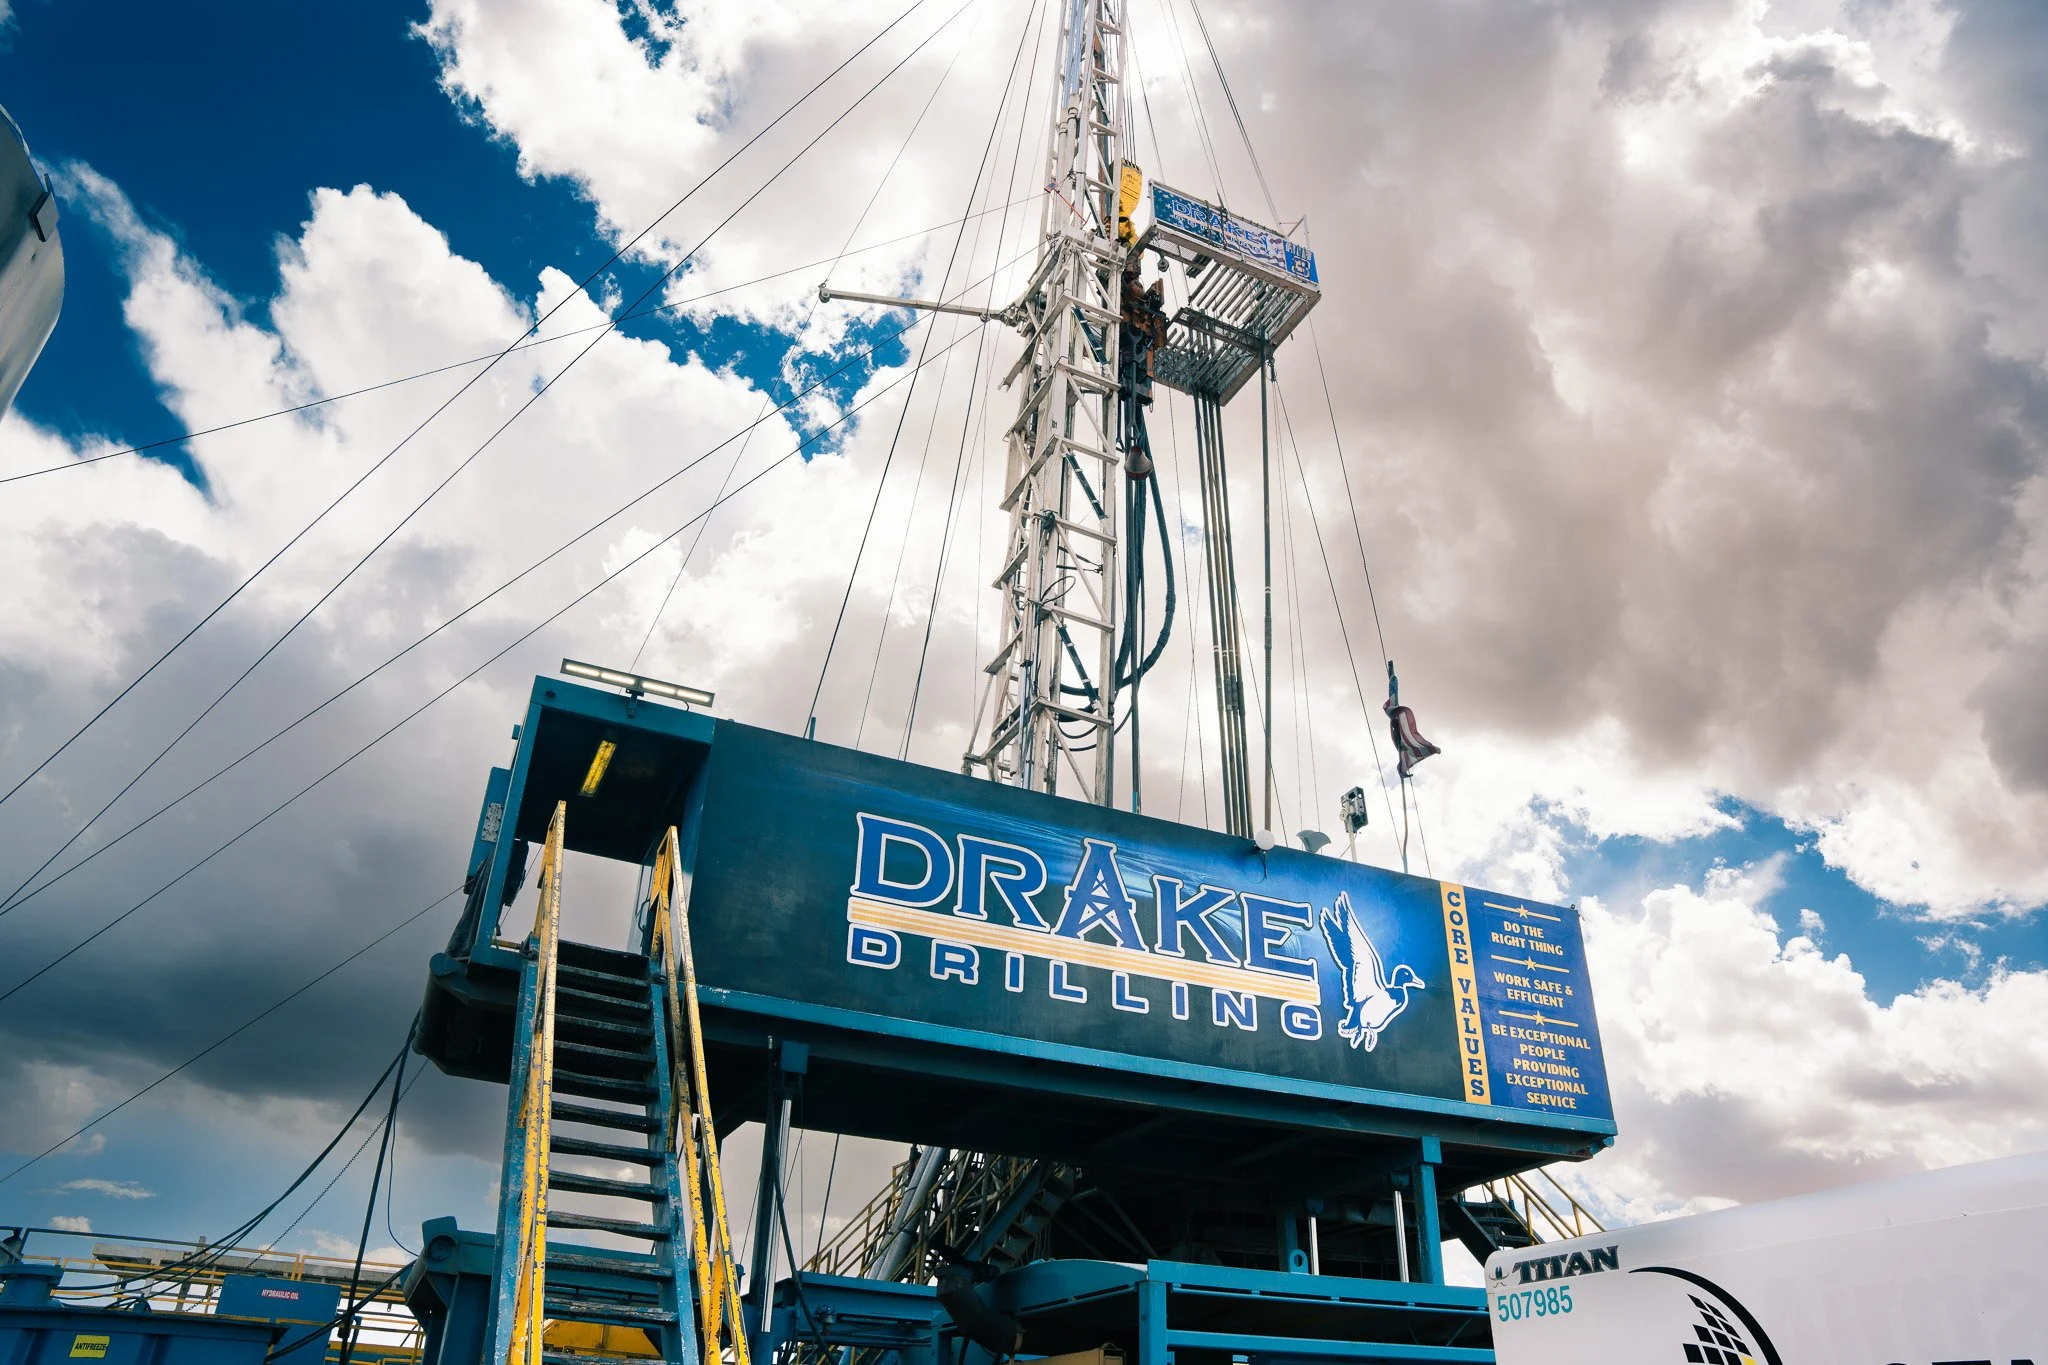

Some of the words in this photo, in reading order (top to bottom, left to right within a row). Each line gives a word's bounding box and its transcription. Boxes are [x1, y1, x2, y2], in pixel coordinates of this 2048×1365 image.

[1173, 199, 1261, 246] DRAKE
[850, 811, 1319, 982] DRAKE
[1446, 891, 1469, 965] CORE
[1503, 920, 1521, 934] DO
[1522, 924, 1544, 939] THE
[1491, 931, 1526, 949] RIGHT
[1528, 939, 1564, 956] THING
[847, 922, 1322, 1040] DRILLING
[1493, 971, 1532, 989] WORK
[1533, 979, 1563, 994] SAFE
[1565, 985, 1574, 997] &
[1506, 988, 1564, 1008] EFFICIENT
[1457, 977, 1485, 1097] VALUES
[1491, 1023, 1508, 1037] BE
[1509, 1026, 1591, 1050] EXCEPTIONAL
[1519, 1043, 1566, 1061] PEOPLE
[1513, 1057, 1580, 1079] PROVIDING
[1505, 1072, 1589, 1095] EXCEPTIONAL
[1526, 1091, 1577, 1109] SERVICE
[1512, 1245, 1620, 1285] TITAN
[261, 1289, 290, 1299] HYDRAULIC
[290, 1292, 299, 1300] OIL
[1497, 1285, 1573, 1322] 507985
[75, 1342, 107, 1351] ANTIFREEZE
